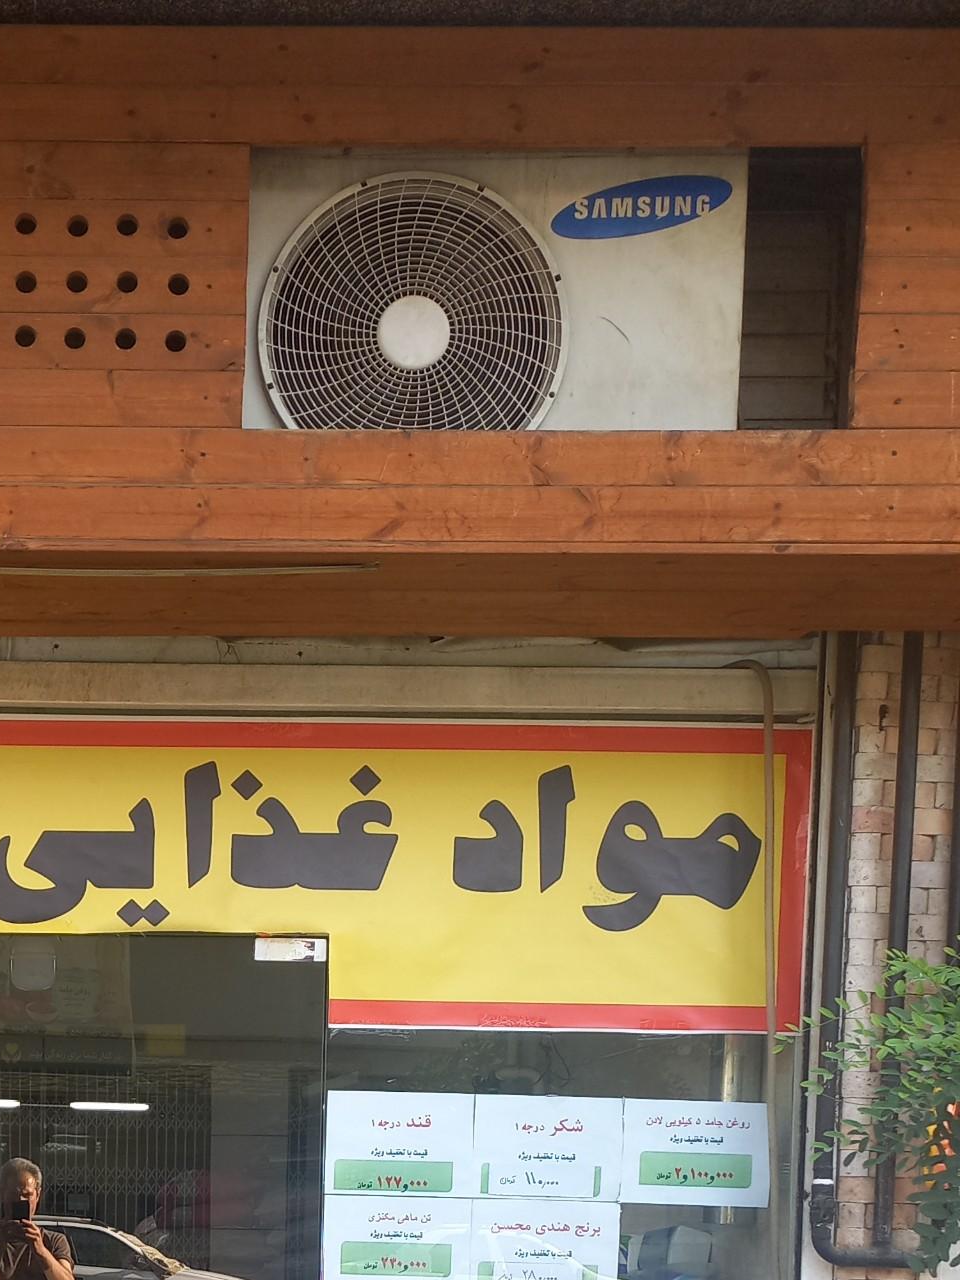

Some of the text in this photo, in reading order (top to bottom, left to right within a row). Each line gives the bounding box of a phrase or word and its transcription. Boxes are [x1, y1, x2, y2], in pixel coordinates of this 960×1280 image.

[574, 195, 711, 220] SAMSUNG
[453, 764, 761, 932] مواد
[378, 1120, 400, 1130] درجه
[406, 1115, 431, 1128] قند
[647, 1117, 663, 1125] لادن
[666, 1117, 692, 1127] کیلویی
[705, 1117, 723, 1126] جامد
[726, 1118, 750, 1129] روغن
[522, 1123, 544, 1134] درجه
[550, 1119, 583, 1136] شکر
[670, 1134, 682, 1143] ویژه
[684, 1136, 703, 1144] تخفیف
[710, 1137, 723, 1145] قیمت
[371, 1148, 384, 1157] ویژه
[386, 1149, 405, 1158] تخفیف
[413, 1149, 428, 1158] قیمت
[518, 1152, 531, 1161] ویژه
[533, 1153, 553, 1162] تخفیف
[561, 1154, 575, 1162] قیمت
[368, 1212, 431, 1224] تن ماهی مکنزی
[491, 1222, 600, 1237] برنج هندی محسن
[370, 1230, 382, 1239] ویژه
[384, 1231, 402, 1239] تخفیف
[409, 1232, 422, 1240] قیمت
[515, 1248, 528, 1258] ویژه
[530, 1250, 550, 1258] تخفیف
[557, 1250, 572, 1259] قیمت
